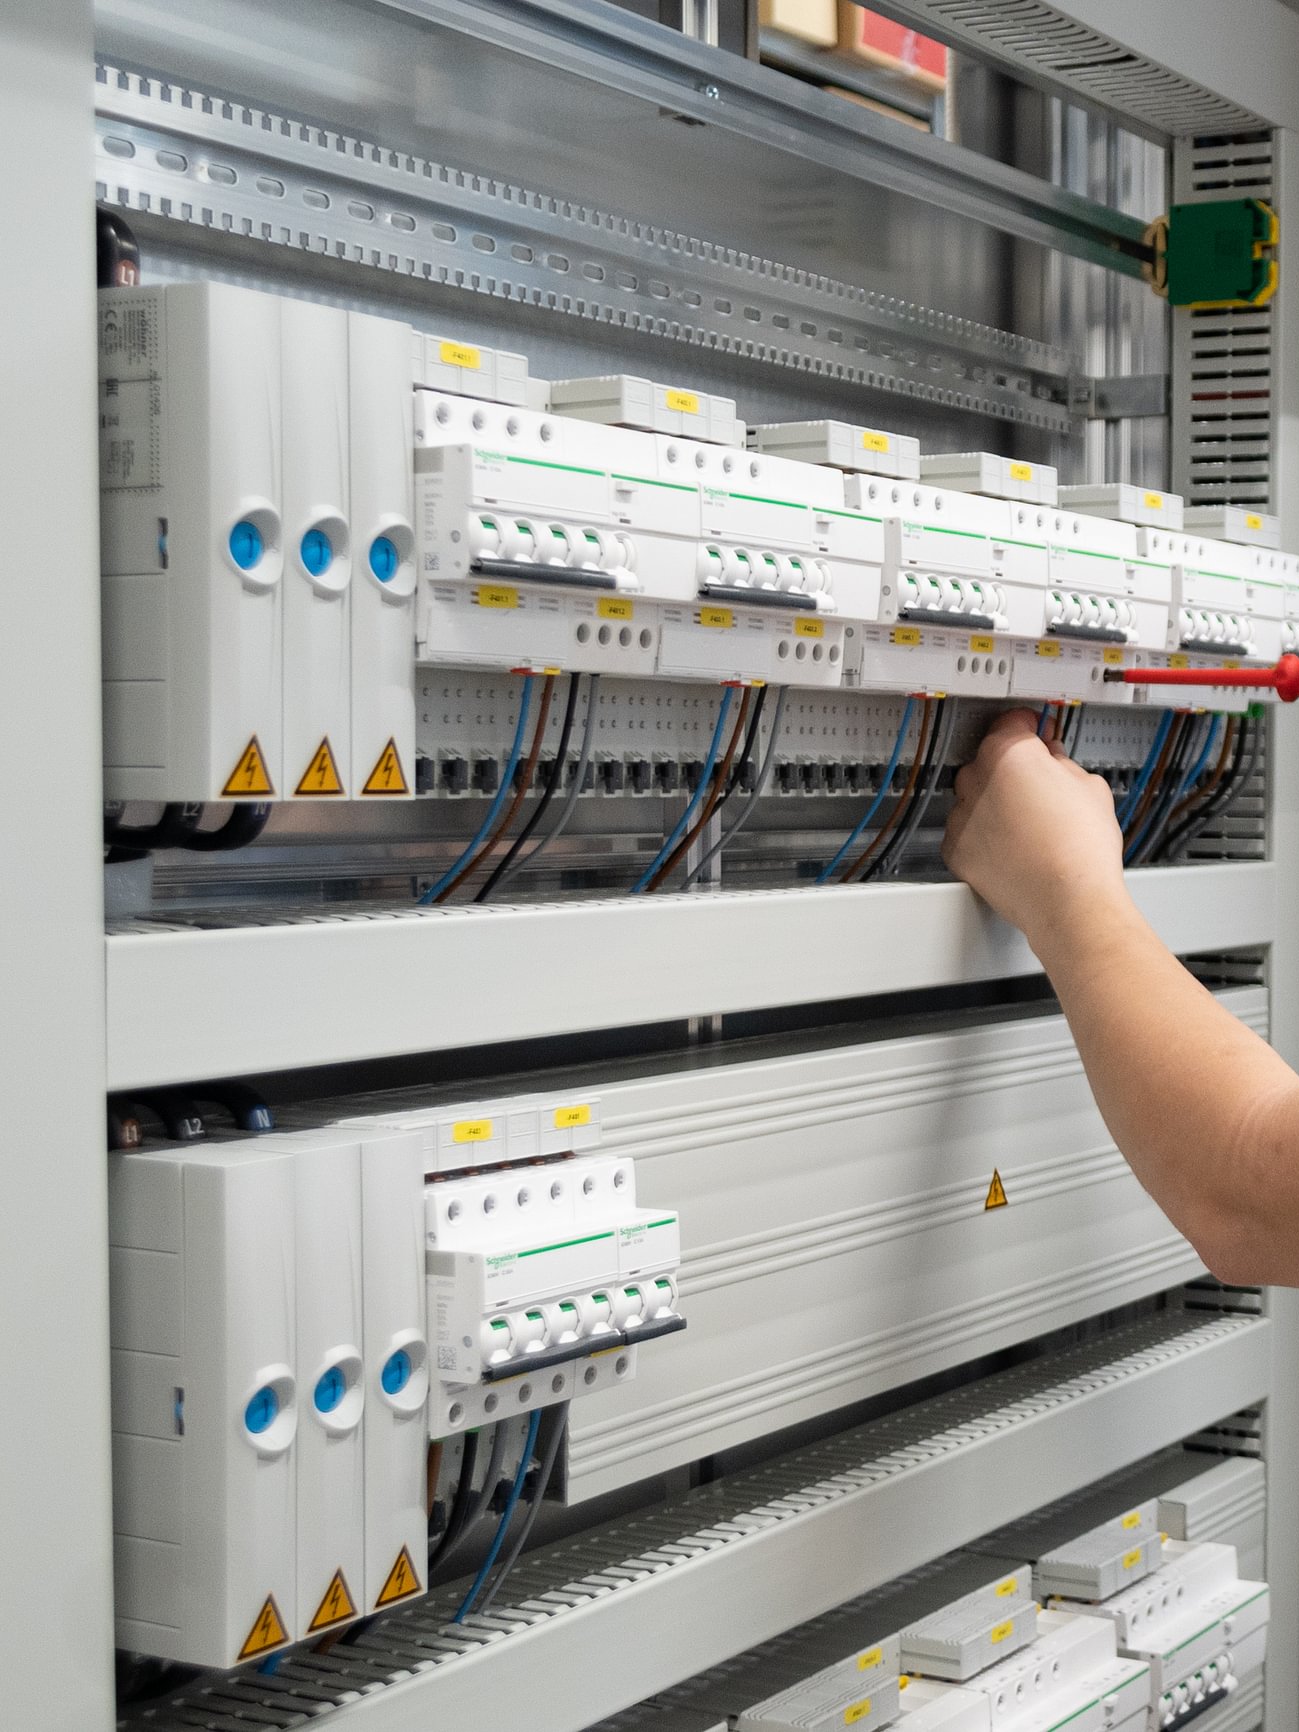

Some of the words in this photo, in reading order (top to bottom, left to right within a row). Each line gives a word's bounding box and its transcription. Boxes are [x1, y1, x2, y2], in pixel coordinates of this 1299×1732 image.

[184, 1117, 205, 1136] L2
[256, 1108, 271, 1128] N
[125, 1125, 138, 1142] L1
